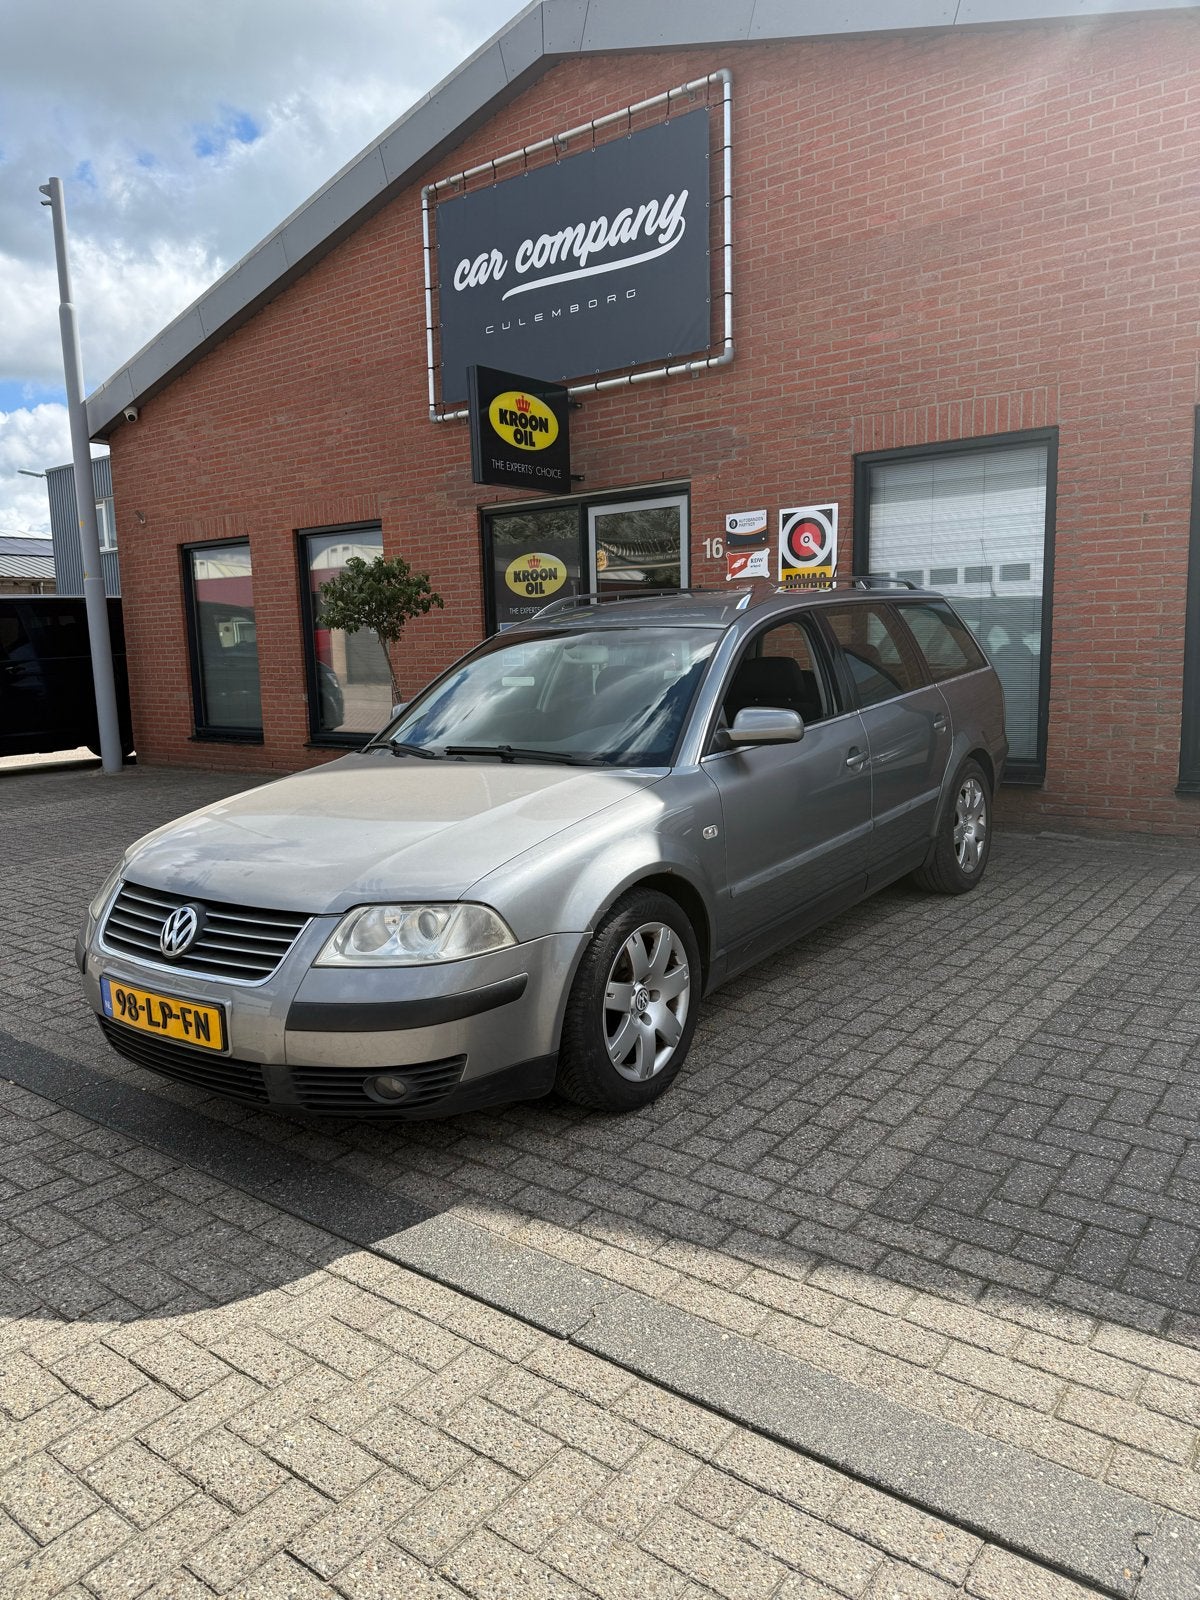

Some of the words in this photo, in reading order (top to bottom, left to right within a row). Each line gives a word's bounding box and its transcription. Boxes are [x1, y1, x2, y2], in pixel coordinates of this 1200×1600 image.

[453, 248, 508, 291] car
[514, 189, 689, 275] company
[485, 288, 636, 334] CULEMBORG
[499, 408, 549, 434] KROON
[513, 430, 536, 447] OIL
[491, 459, 505, 470] THE
[535, 466, 562, 479] CHOICE
[702, 537, 724, 559] 16
[513, 567, 558, 583] KROON
[525, 580, 545, 595] OIL
[509, 607, 519, 615] THE
[115, 988, 211, 1042] 98-LP-FN
